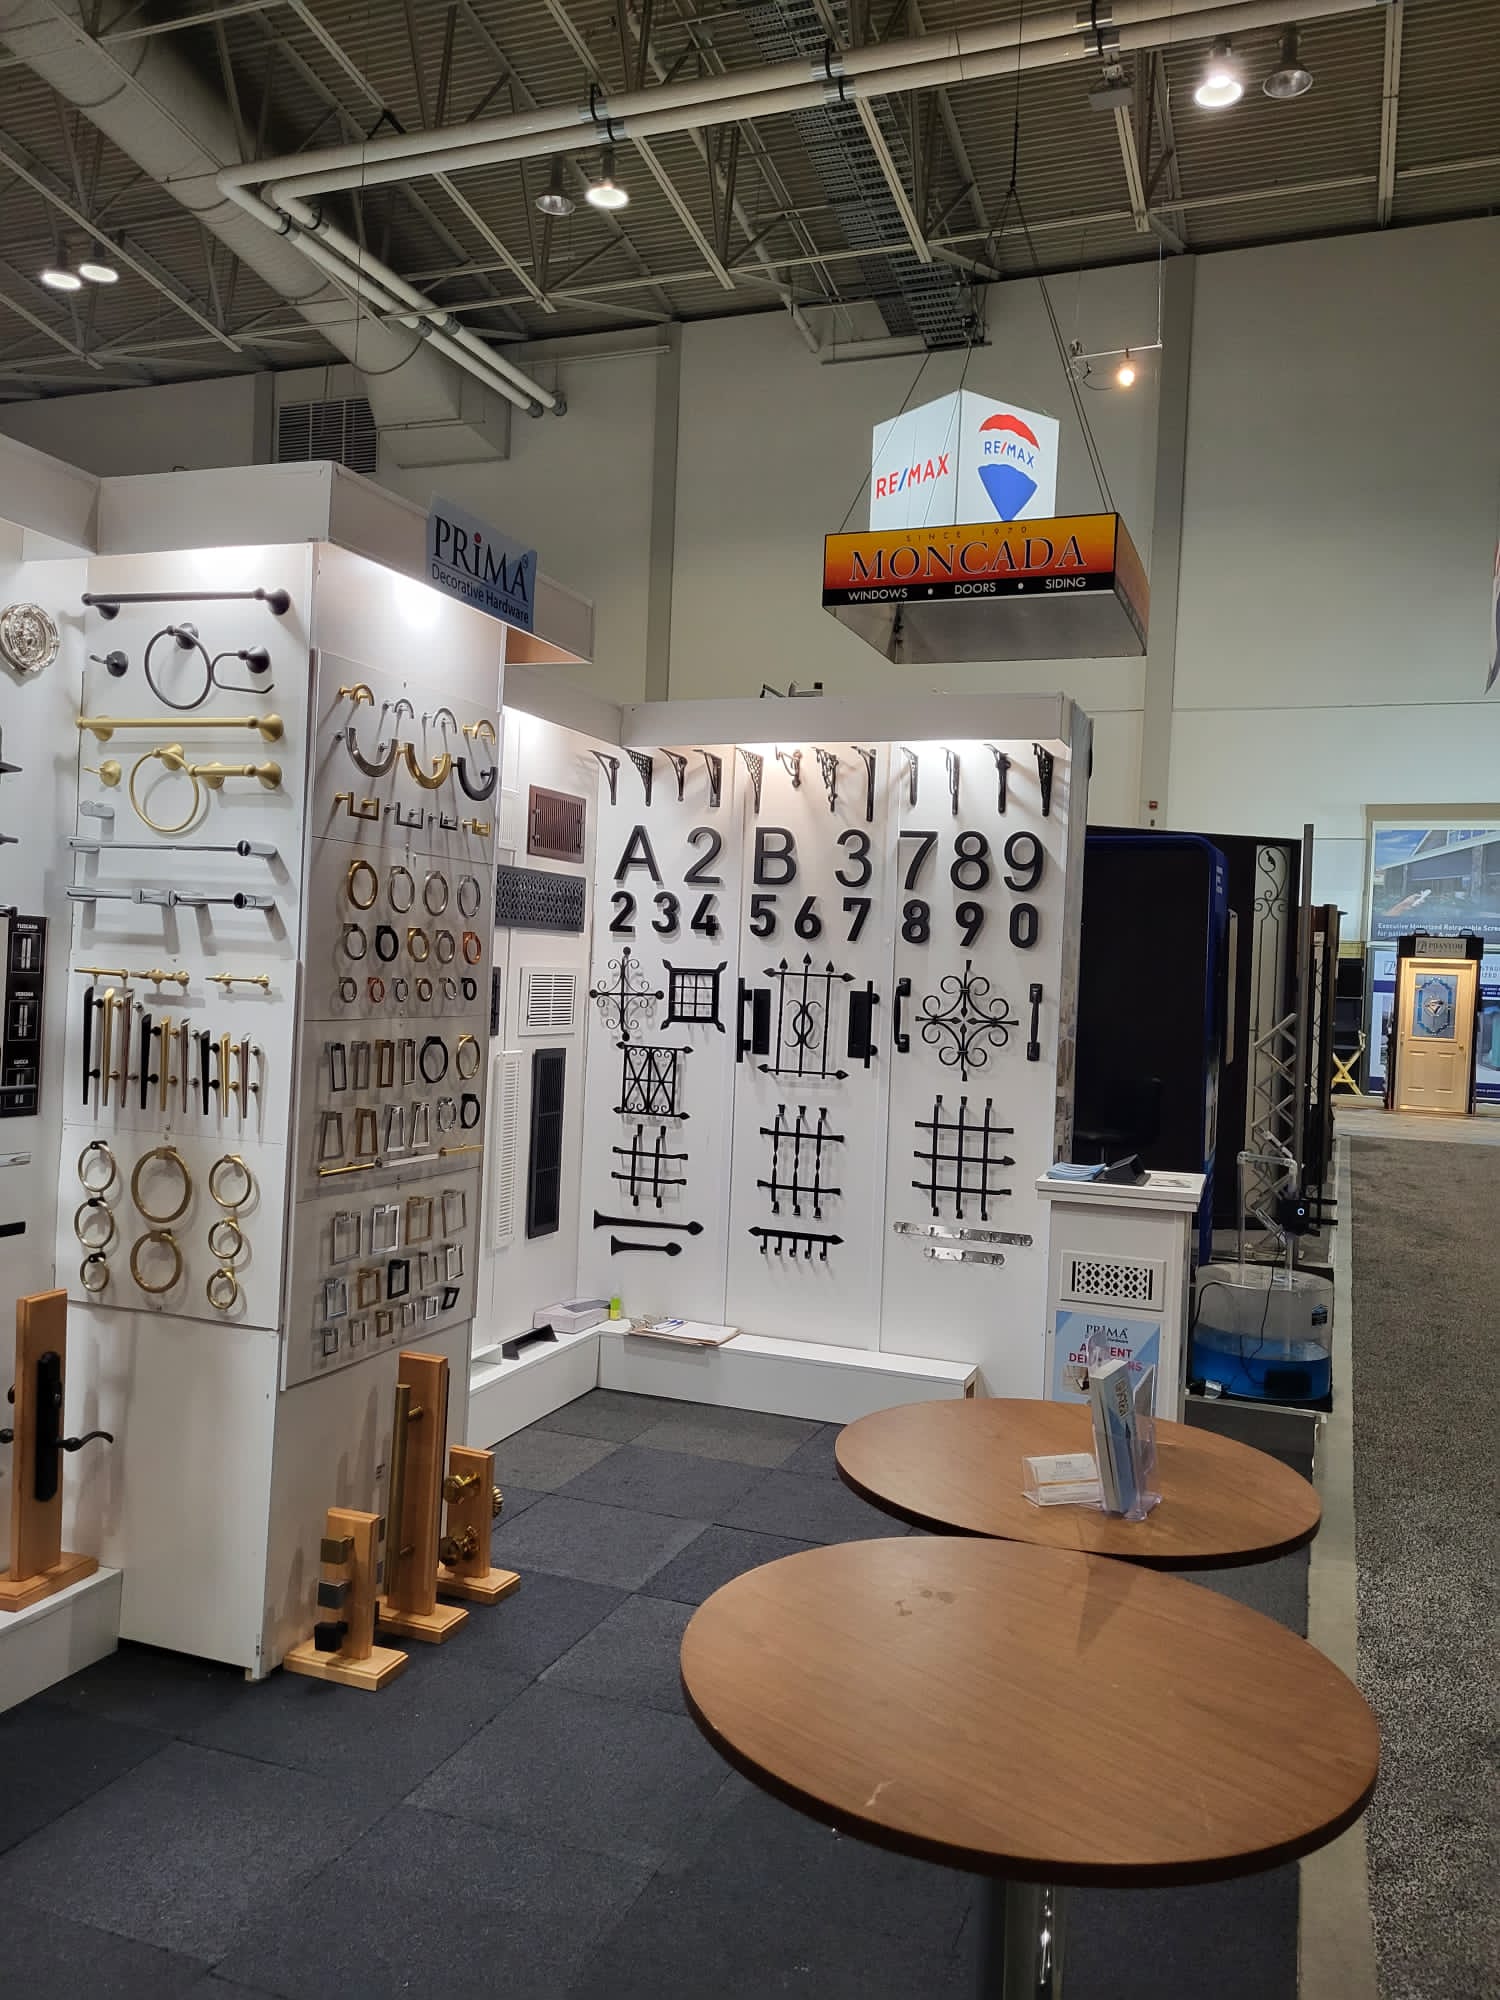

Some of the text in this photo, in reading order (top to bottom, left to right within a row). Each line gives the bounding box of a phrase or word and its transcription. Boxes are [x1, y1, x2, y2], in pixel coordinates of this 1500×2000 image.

[876, 453, 950, 499] RE/MAX
[984, 440, 1035, 469] RE/MAX
[906, 526, 1028, 542] SINCE 1970
[850, 535, 1087, 582] MONCADA
[431, 563, 529, 624] Decorative Hardware
[848, 576, 1087, 602] WINDOWS DOORS SIDING
[614, 825, 1043, 891] A 2 B 3 7 8 9
